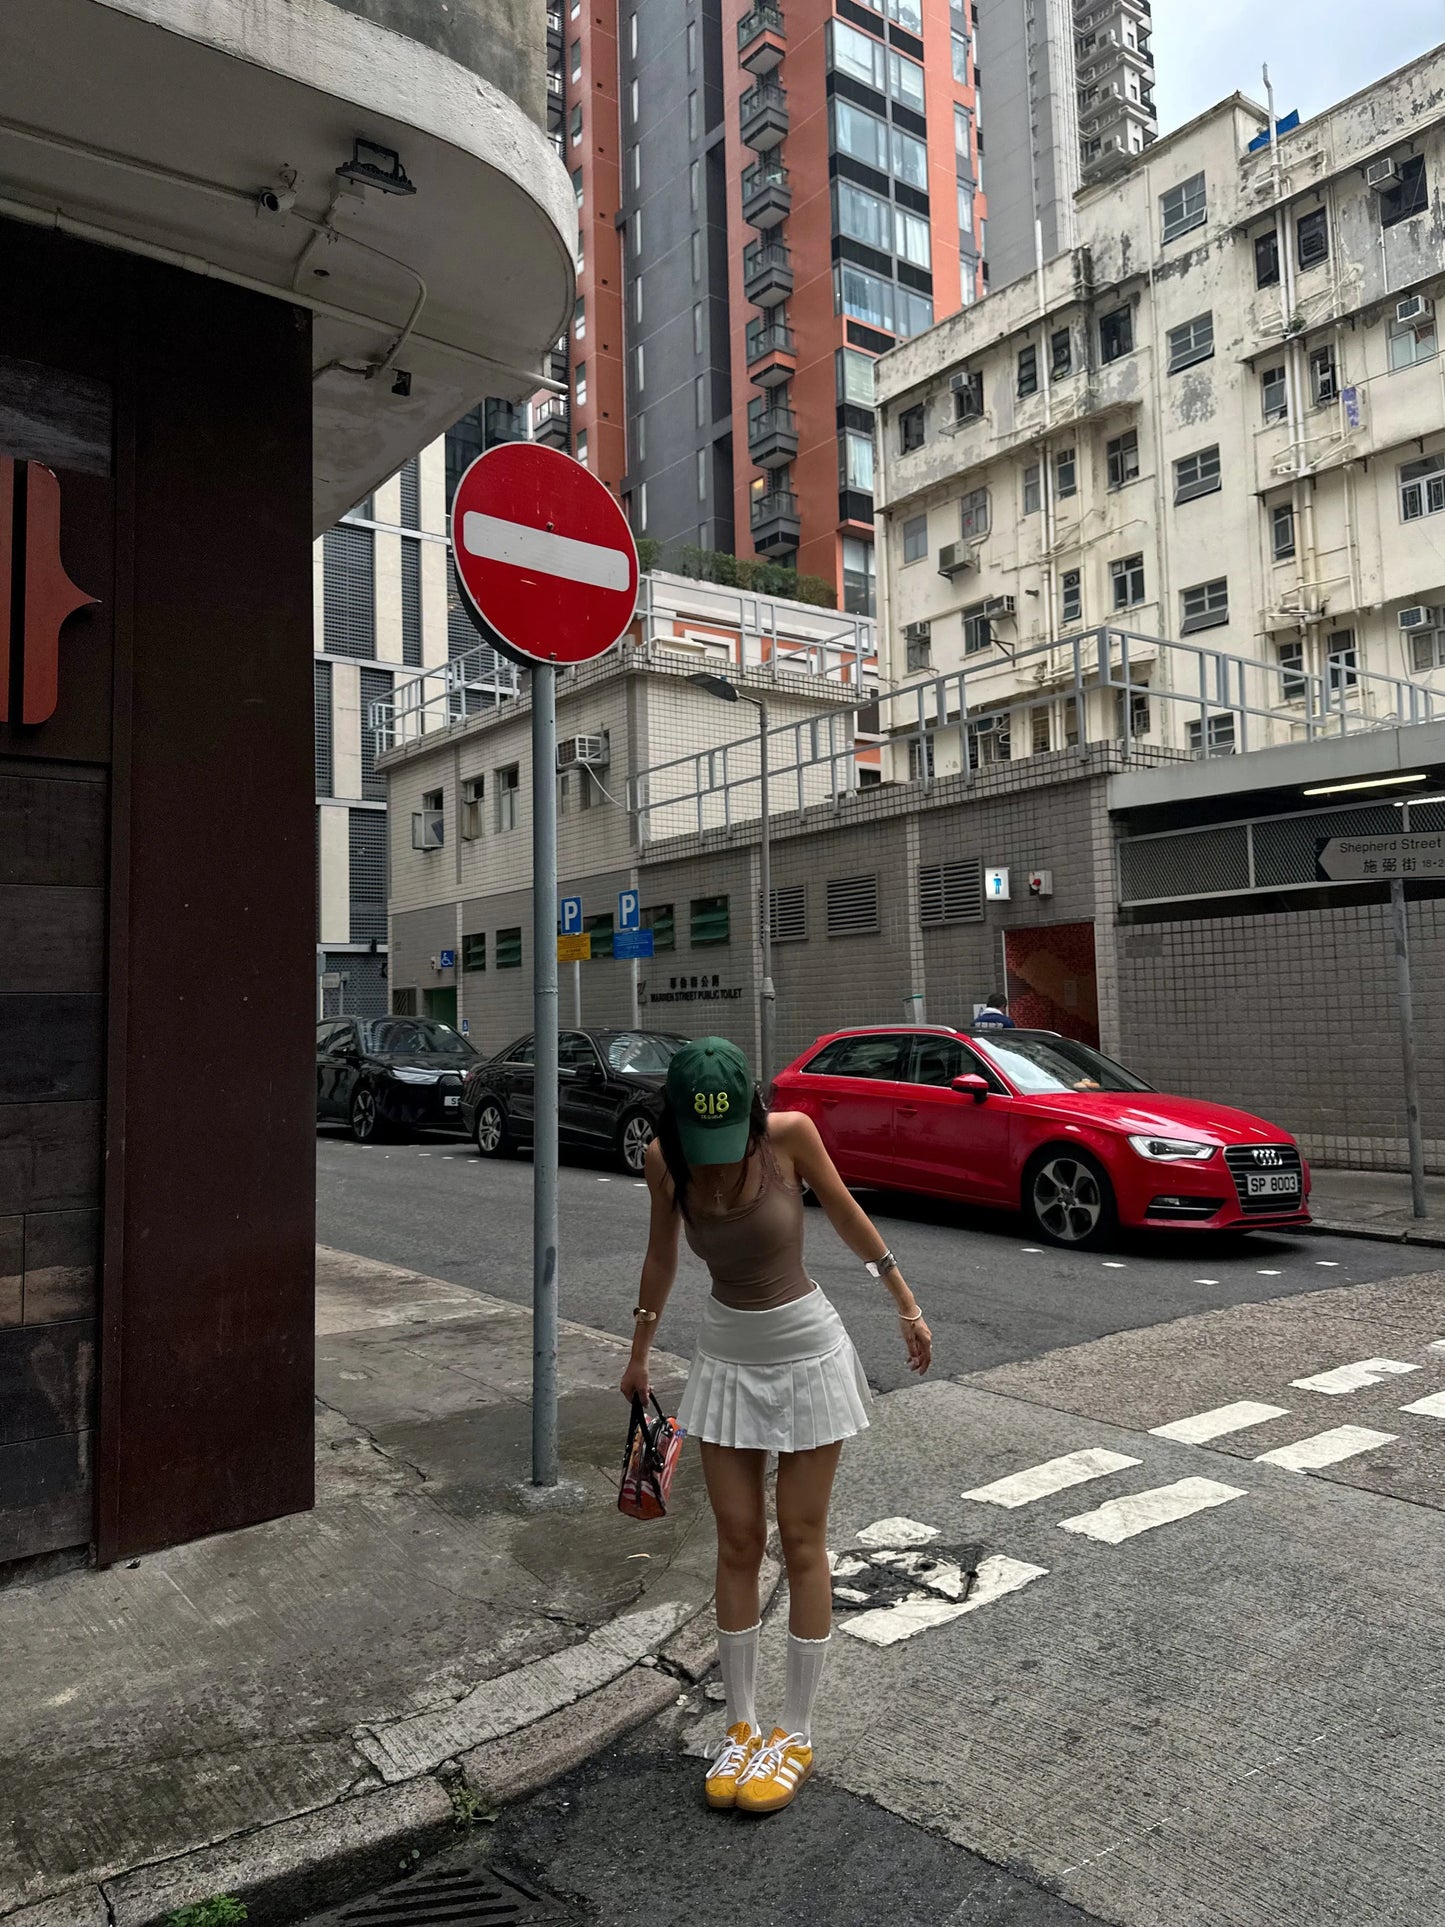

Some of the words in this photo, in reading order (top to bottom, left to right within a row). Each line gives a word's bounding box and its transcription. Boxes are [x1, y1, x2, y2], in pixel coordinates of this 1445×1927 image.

[1340, 840, 1397, 854] Shepherd
[1401, 838, 1441, 850] Street
[564, 901, 578, 931] P
[621, 894, 636, 926] P
[675, 991, 697, 1001] STREET
[698, 990, 719, 1000] PUBLIC
[720, 988, 742, 999] TOILET
[694, 1091, 730, 1115] 818
[1250, 1177, 1266, 1193] SP
[1271, 1175, 1296, 1192] 8003
